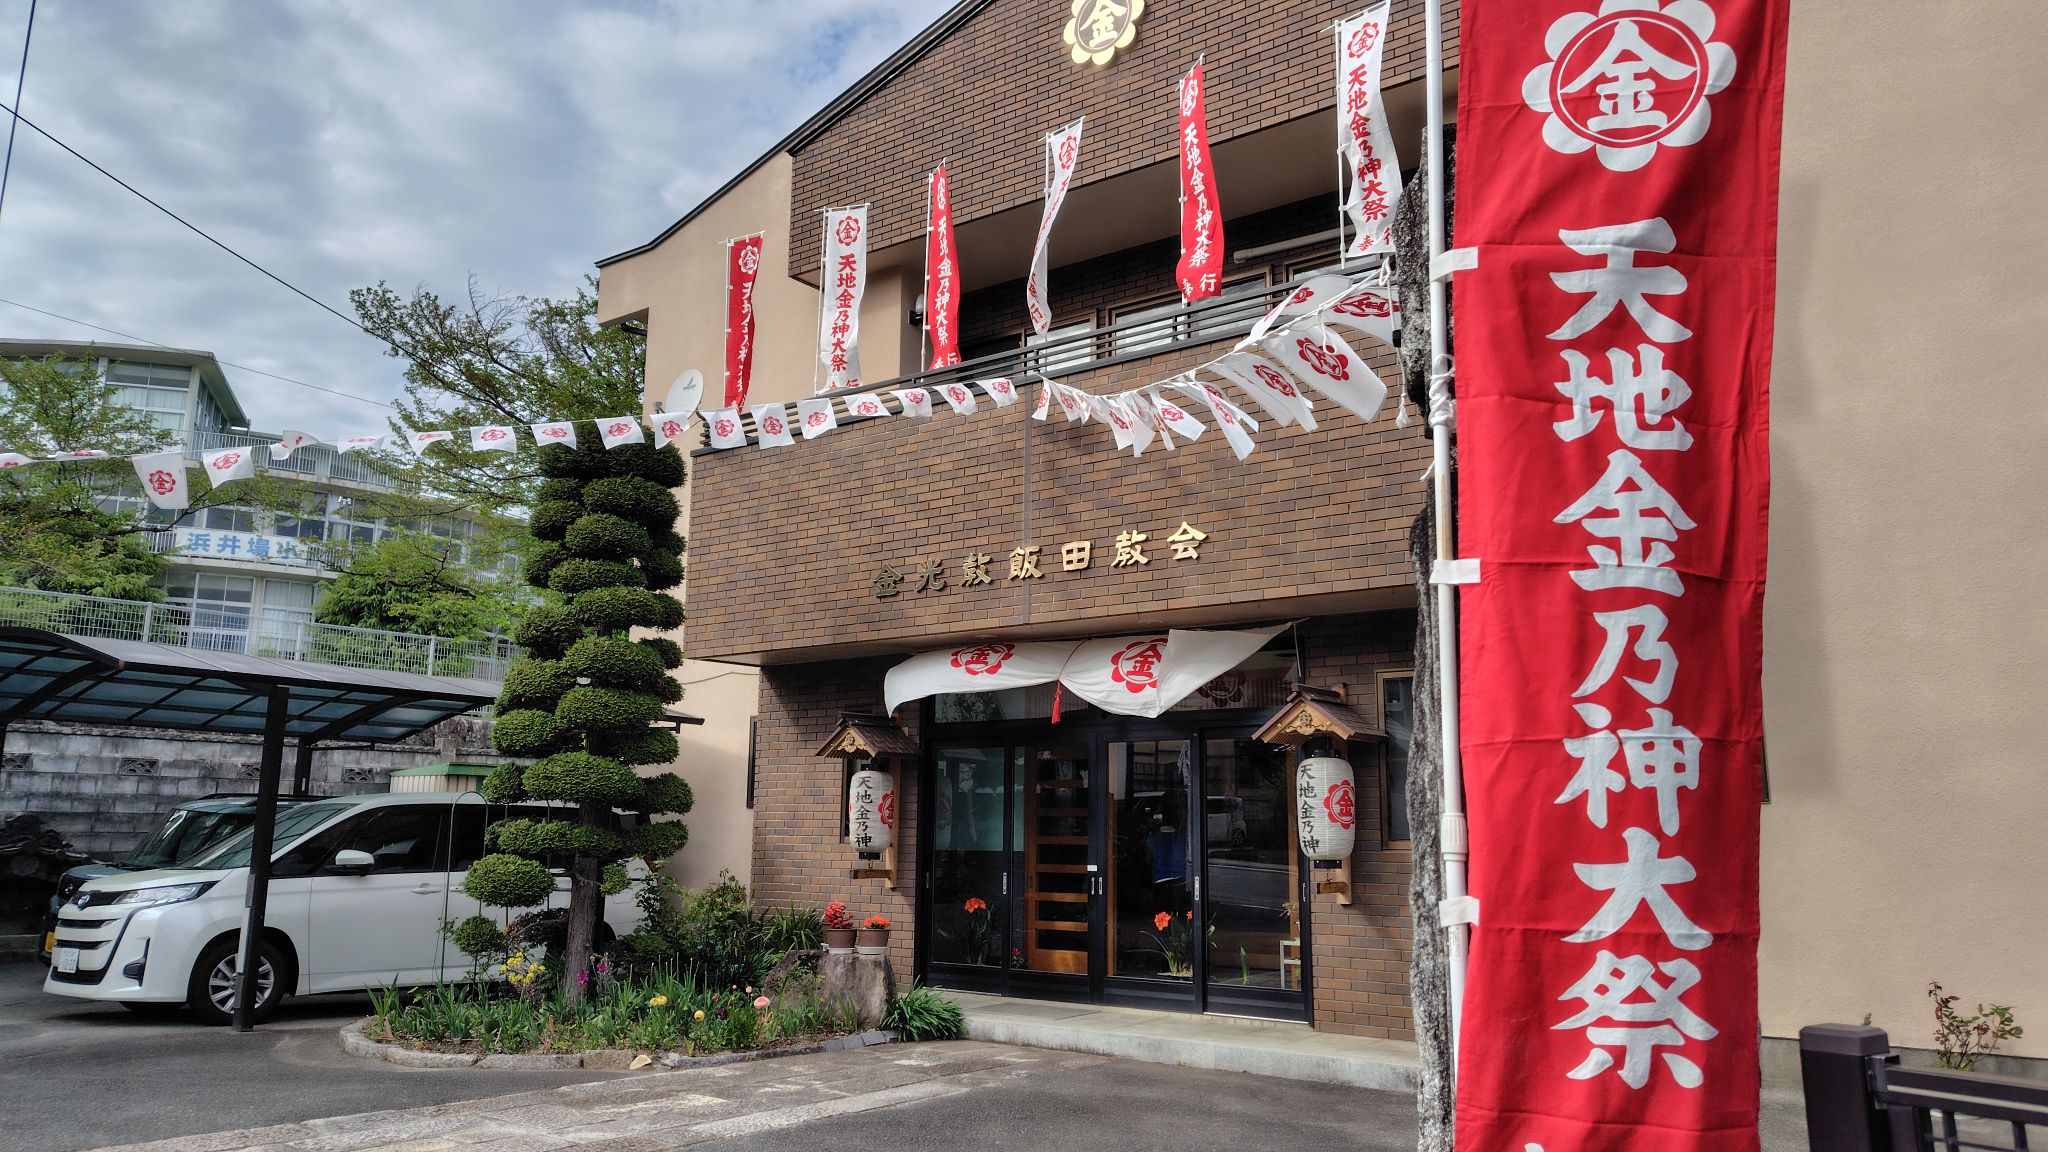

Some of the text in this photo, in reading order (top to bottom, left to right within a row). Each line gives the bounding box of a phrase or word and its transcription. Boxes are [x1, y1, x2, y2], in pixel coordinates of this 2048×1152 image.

[1562, 20, 1696, 130] 金
[1347, 63, 1390, 223] 天地金乃神大祭
[841, 221, 856, 240] 金
[1184, 121, 1213, 268] 天地金乃神大祭
[831, 253, 857, 372] 天地金乃神大祭
[934, 215, 953, 347] 天地金乃神大祭
[155, 476, 169, 490] 金
[186, 532, 298, 560] 浜井場小
[1546, 216, 1719, 1089] 天地金乃神大祭
[855, 776, 873, 847] 天地金乃神
[1299, 763, 1320, 854] 天地金乃神
[1334, 789, 1354, 817] 金
